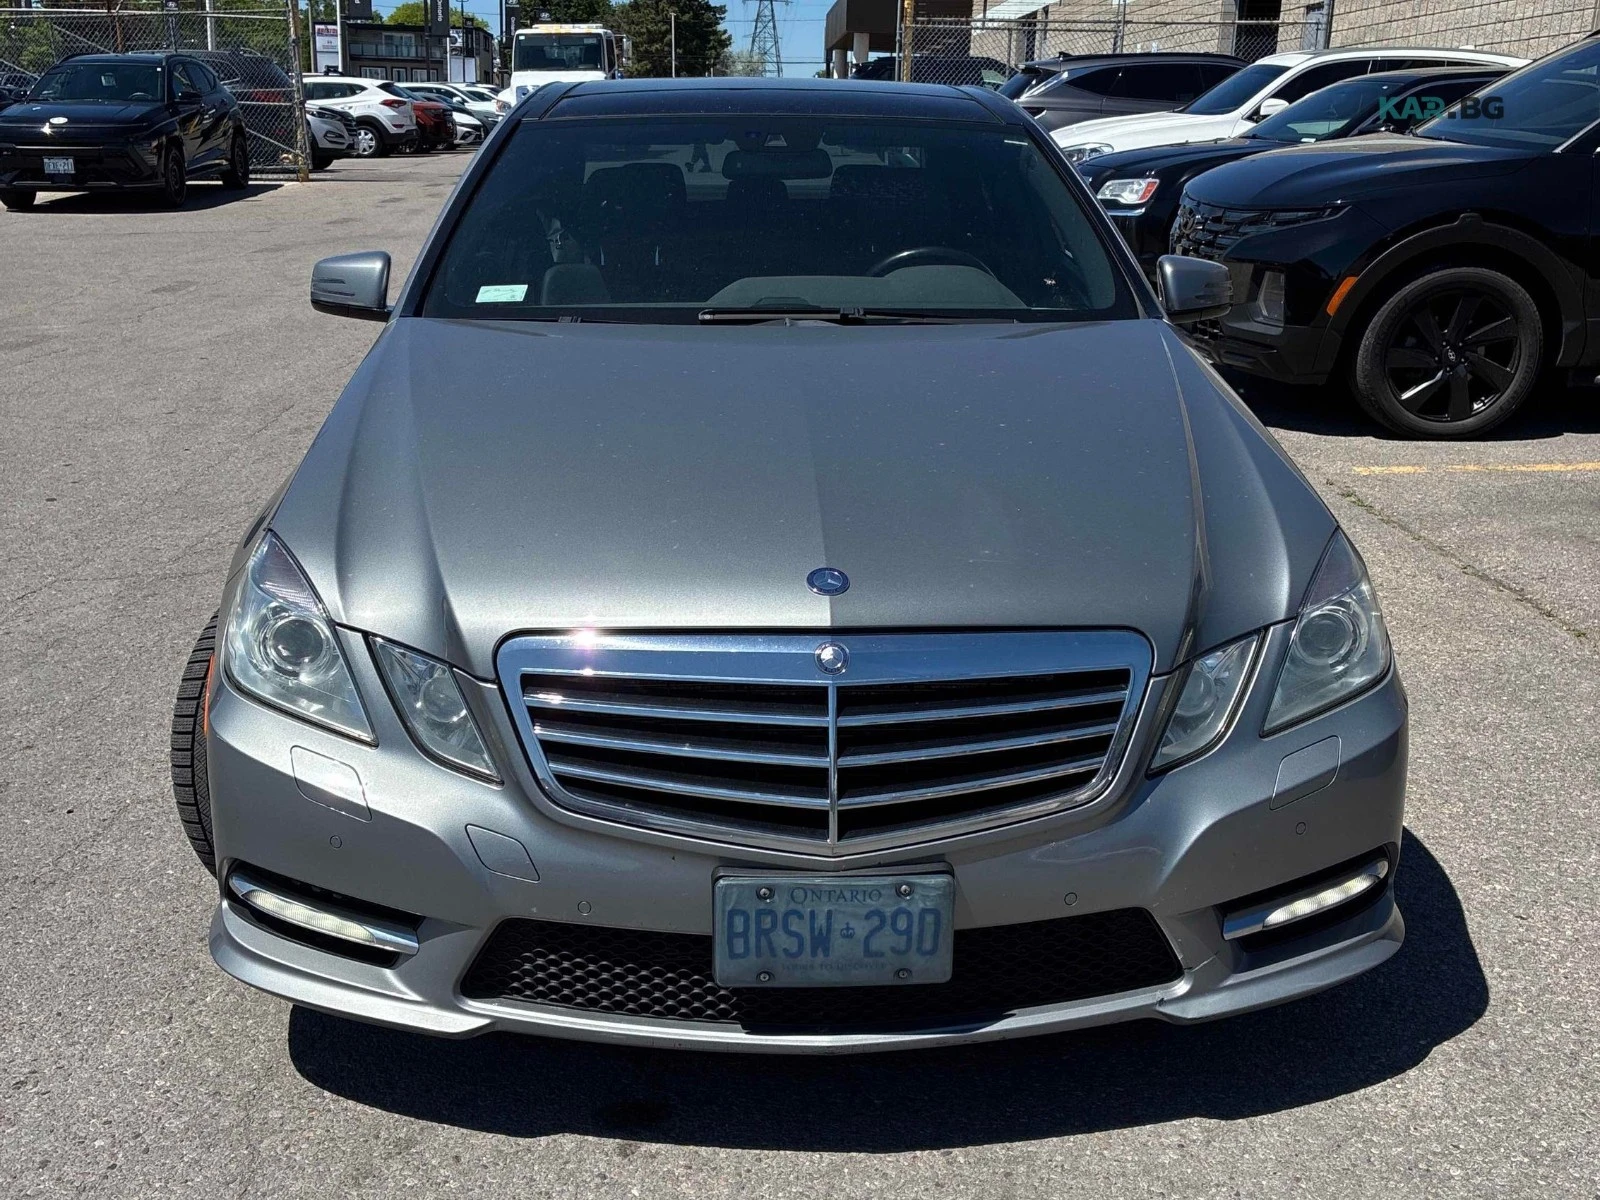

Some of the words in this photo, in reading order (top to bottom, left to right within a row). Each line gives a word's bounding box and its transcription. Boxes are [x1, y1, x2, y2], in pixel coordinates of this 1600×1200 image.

[790, 886, 882, 906] ONTARIO
[727, 908, 834, 960] BRSW
[863, 907, 941, 959] 290
